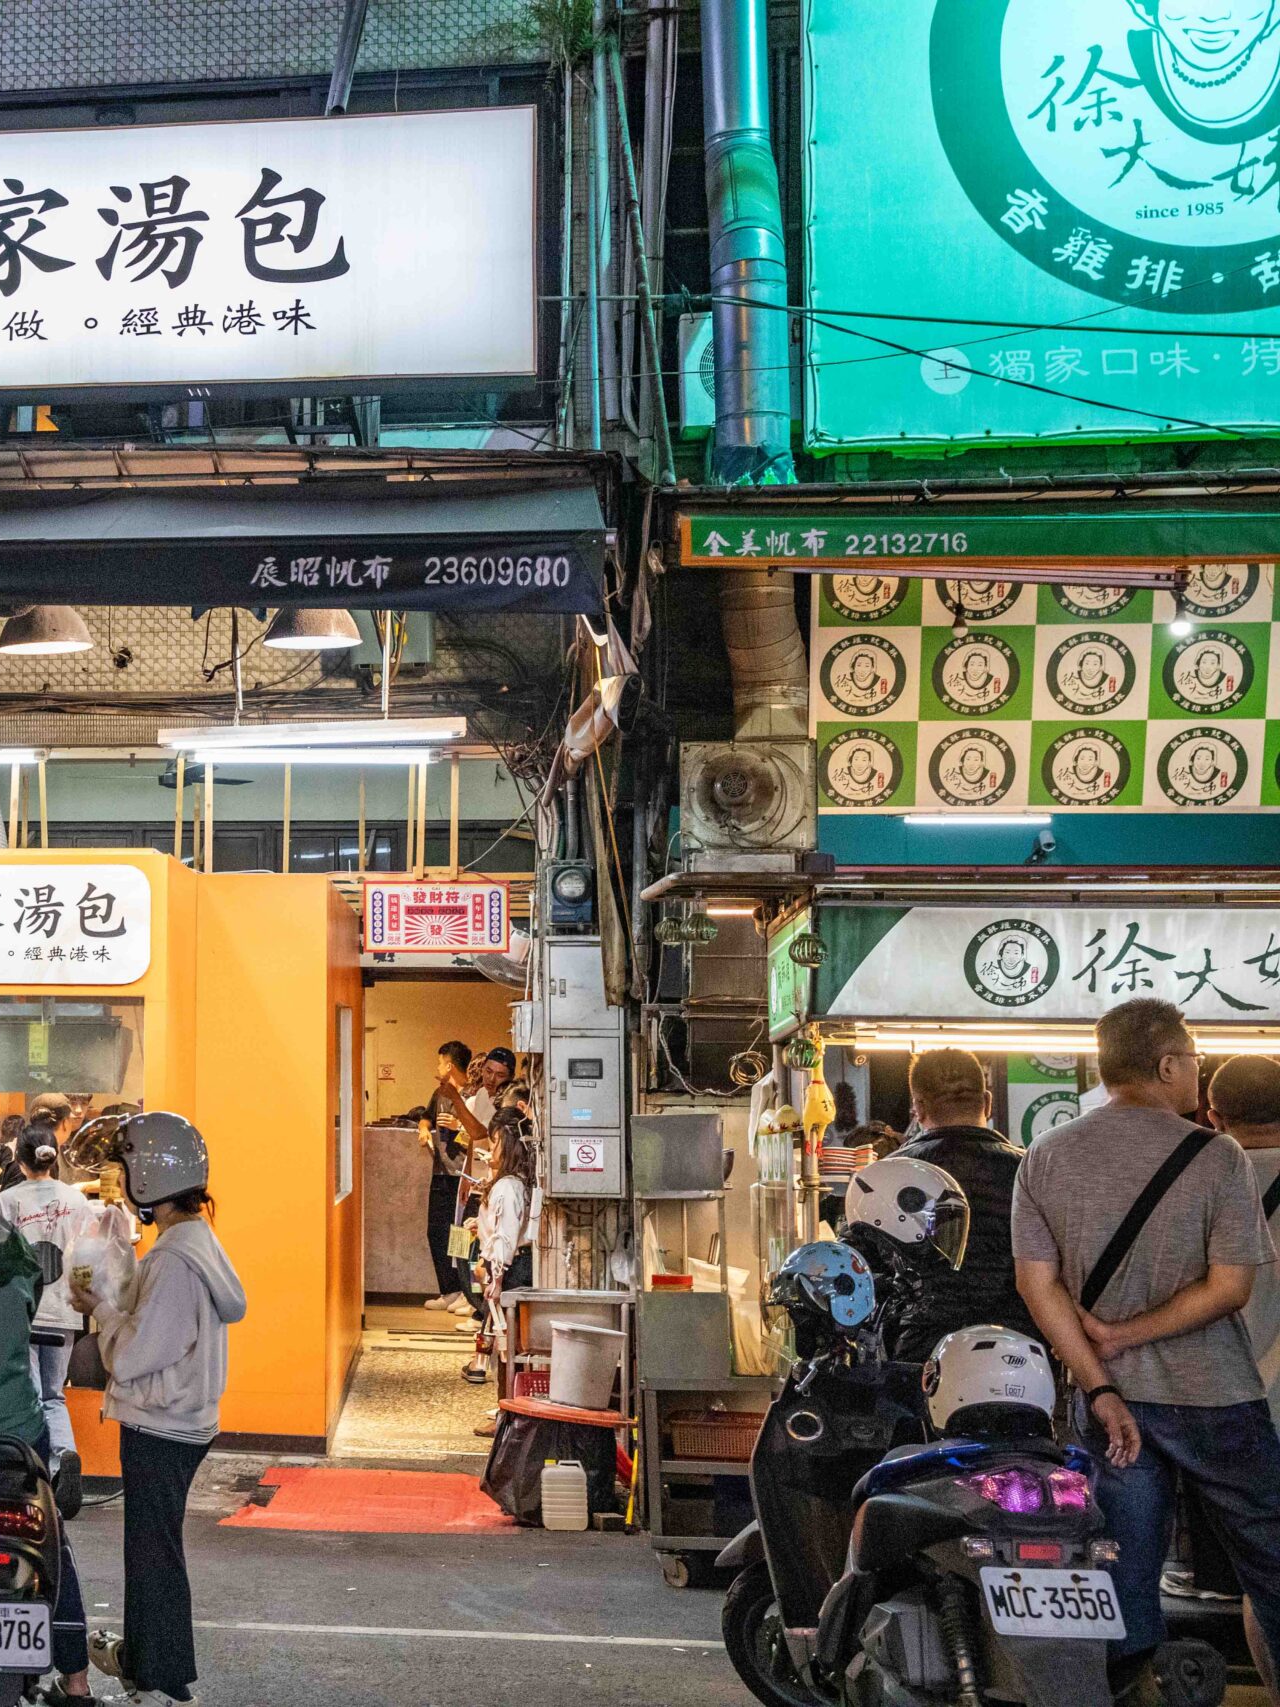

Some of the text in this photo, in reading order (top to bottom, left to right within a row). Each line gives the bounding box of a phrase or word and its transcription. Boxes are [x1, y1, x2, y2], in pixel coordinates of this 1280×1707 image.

[1134, 202, 1225, 220] since 1985
[845, 533, 968, 556] 22132716
[424, 556, 570, 587] 23609680
[413, 891, 460, 904] 發財符
[430, 924, 443, 936] 發
